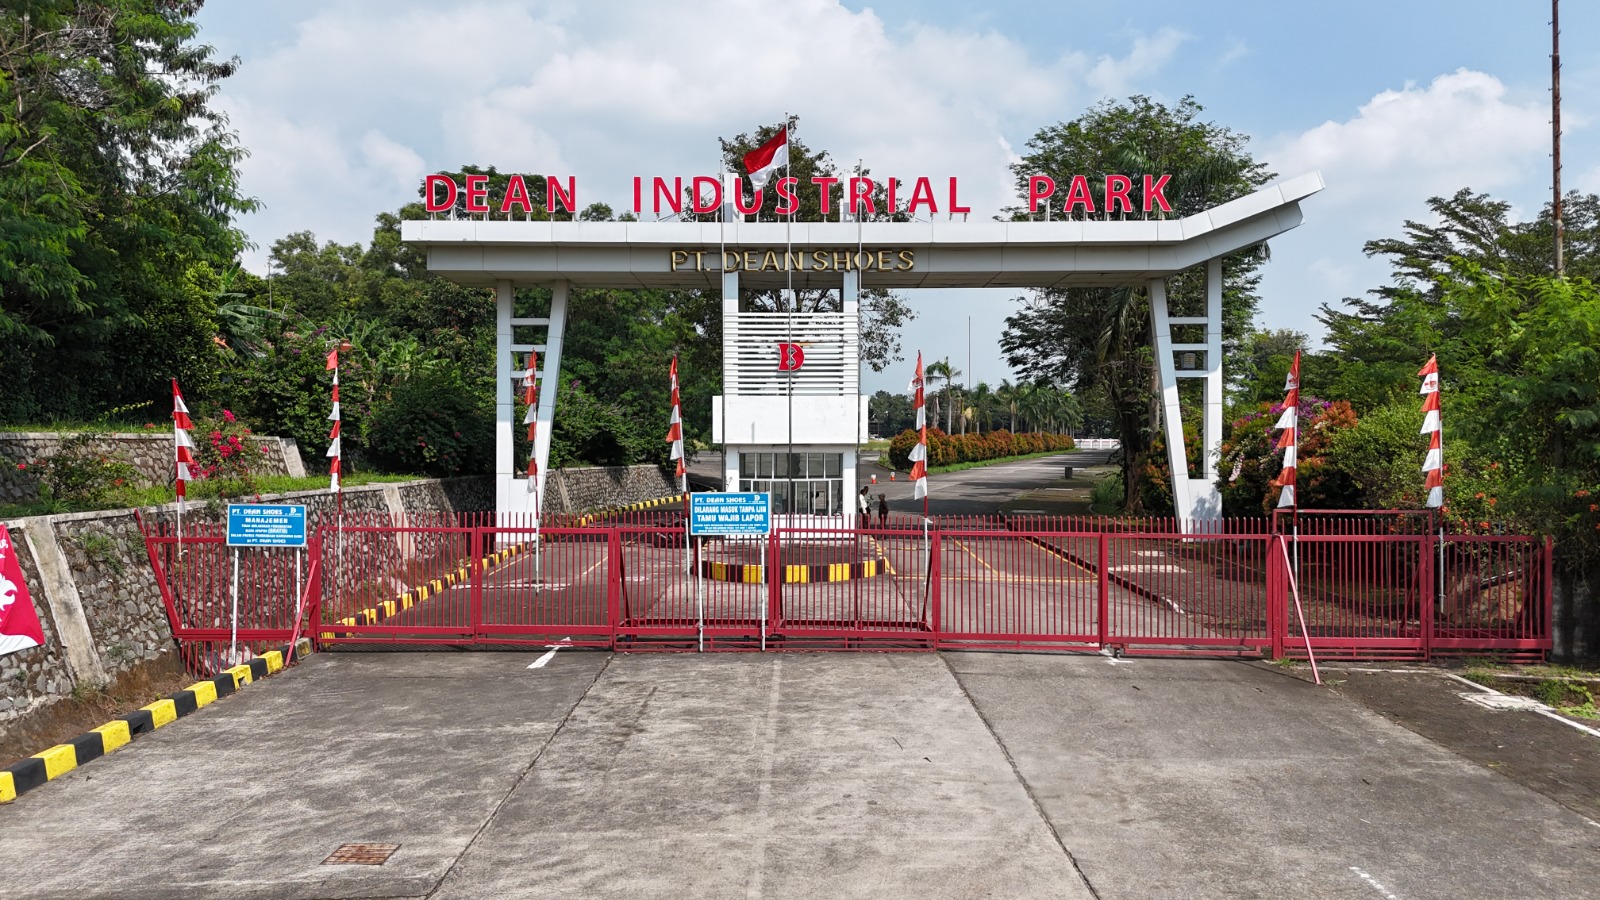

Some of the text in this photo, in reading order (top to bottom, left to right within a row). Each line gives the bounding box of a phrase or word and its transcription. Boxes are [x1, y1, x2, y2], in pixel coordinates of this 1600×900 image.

[425, 174, 1173, 215] DEAN INDUSTRIAL PARK
[670, 250, 915, 272] PT. DEAN SHOES
[697, 514, 764, 522] TAMU WAJIB LAPOR
